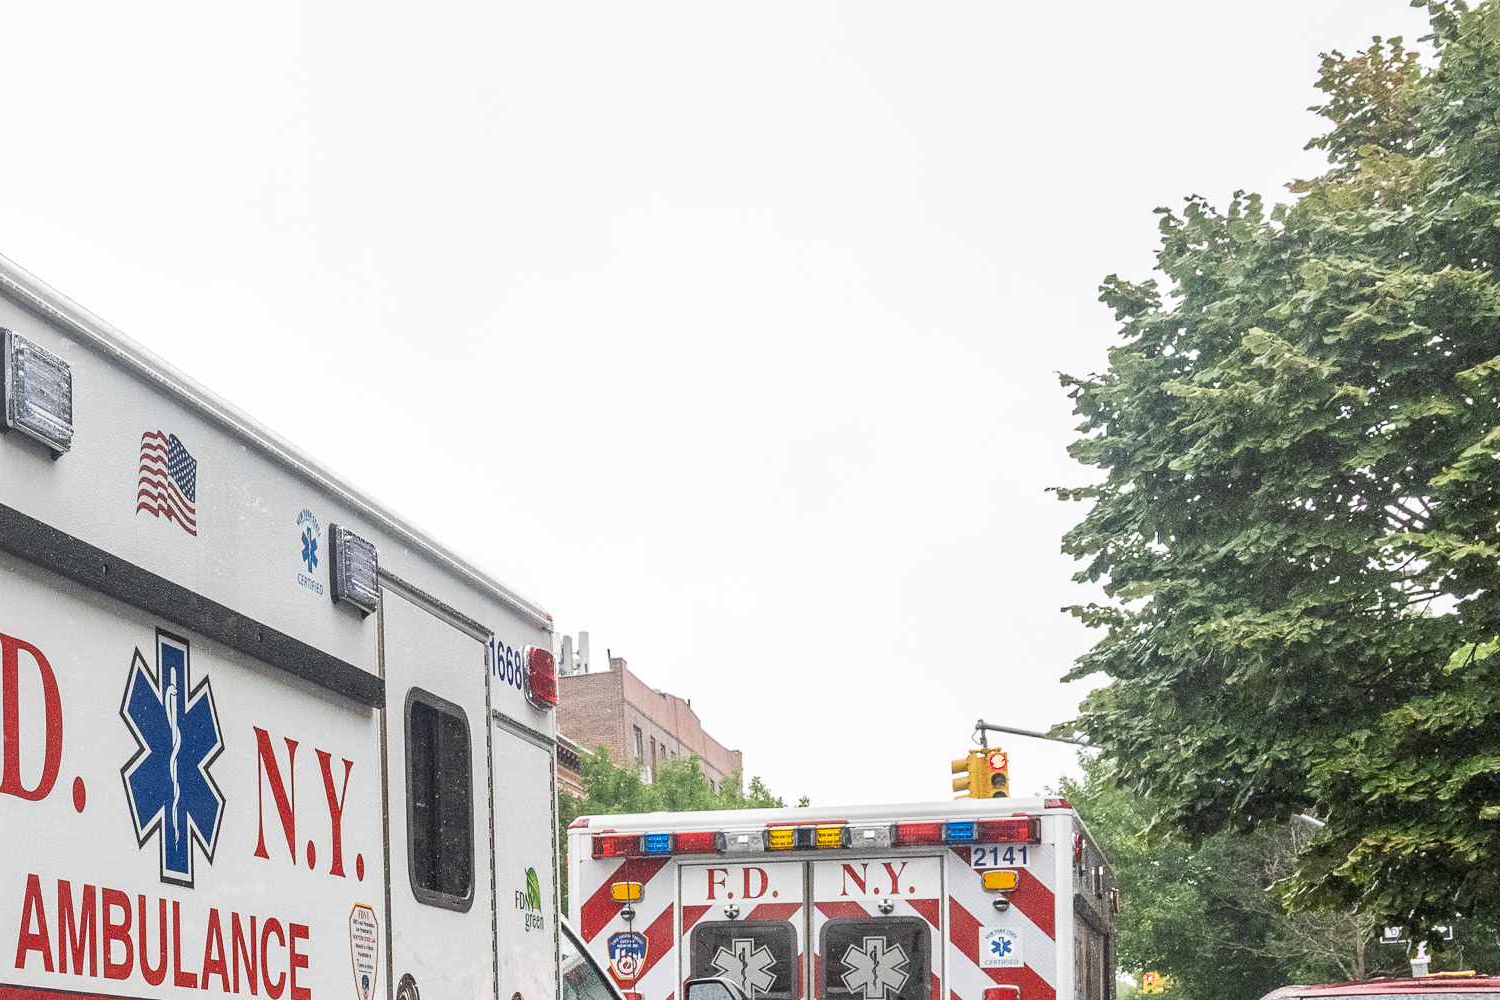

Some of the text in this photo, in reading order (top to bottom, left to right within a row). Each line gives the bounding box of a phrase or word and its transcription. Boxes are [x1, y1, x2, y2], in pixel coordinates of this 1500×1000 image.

[298, 574, 323, 595] CERTIFIED
[490, 637, 522, 690] 1668
[254, 726, 365, 882] N.Y.
[974, 846, 1027, 866] 2141
[706, 862, 916, 900] F.D. N.Y.
[516, 891, 533, 912] FDNY
[525, 913, 544, 932] green
